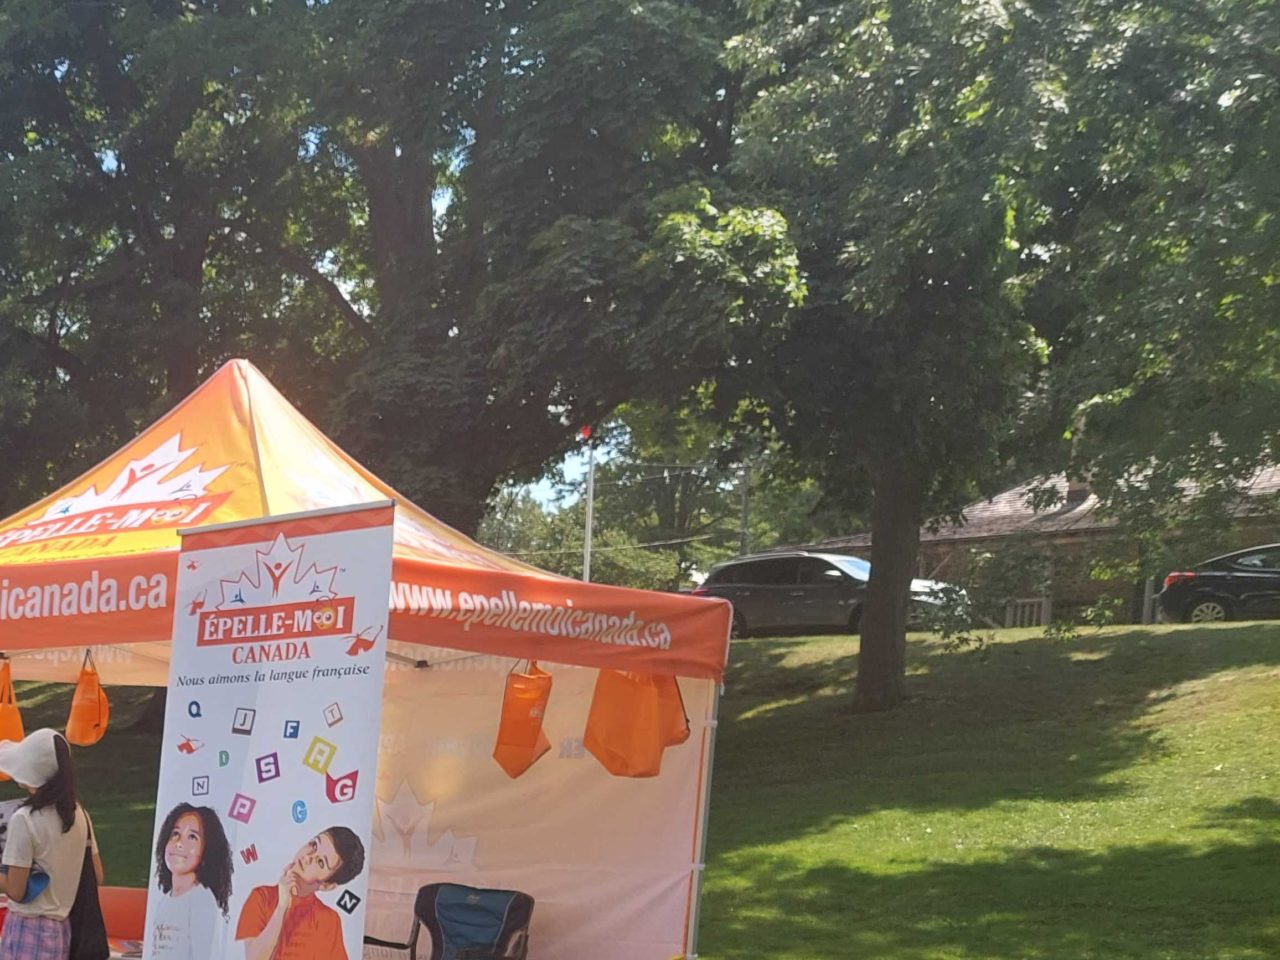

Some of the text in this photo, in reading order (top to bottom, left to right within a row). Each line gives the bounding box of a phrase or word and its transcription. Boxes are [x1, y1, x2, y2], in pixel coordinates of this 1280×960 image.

[231, 641, 312, 665] CANADA
[176, 664, 371, 688] Nous aimons la langue française
[188, 700, 202, 719] Q
[286, 721, 298, 737] F
[218, 750, 230, 767] D
[259, 756, 276, 779] S
[334, 778, 354, 801] G
[232, 798, 252, 816] P
[291, 800, 308, 824] G
[240, 843, 259, 865] W
[339, 892, 357, 910] N
